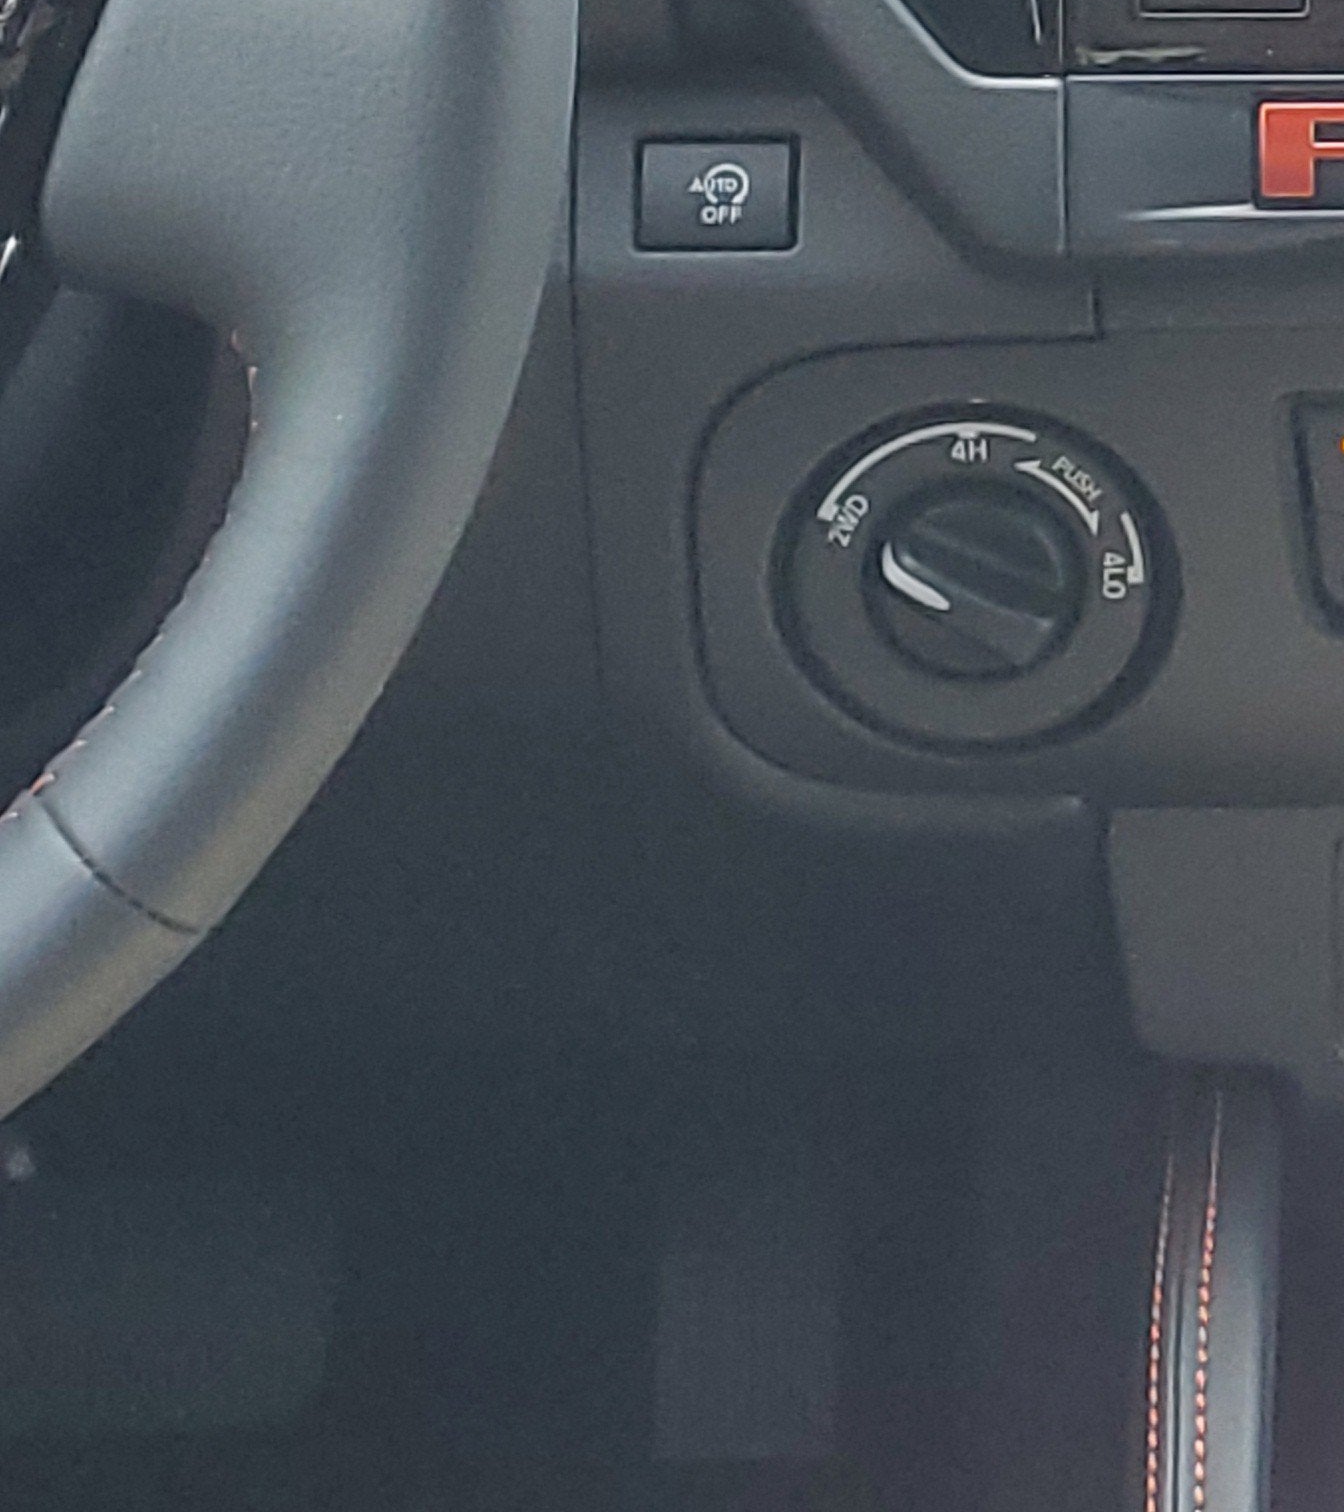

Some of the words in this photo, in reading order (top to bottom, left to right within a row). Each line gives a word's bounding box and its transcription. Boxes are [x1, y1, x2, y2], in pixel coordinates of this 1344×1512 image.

[700, 204, 743, 225] OFF
[950, 438, 989, 462] 4H
[1051, 455, 1102, 501] PUSH
[827, 493, 870, 548] 2WD
[1102, 552, 1127, 600] 4LO
